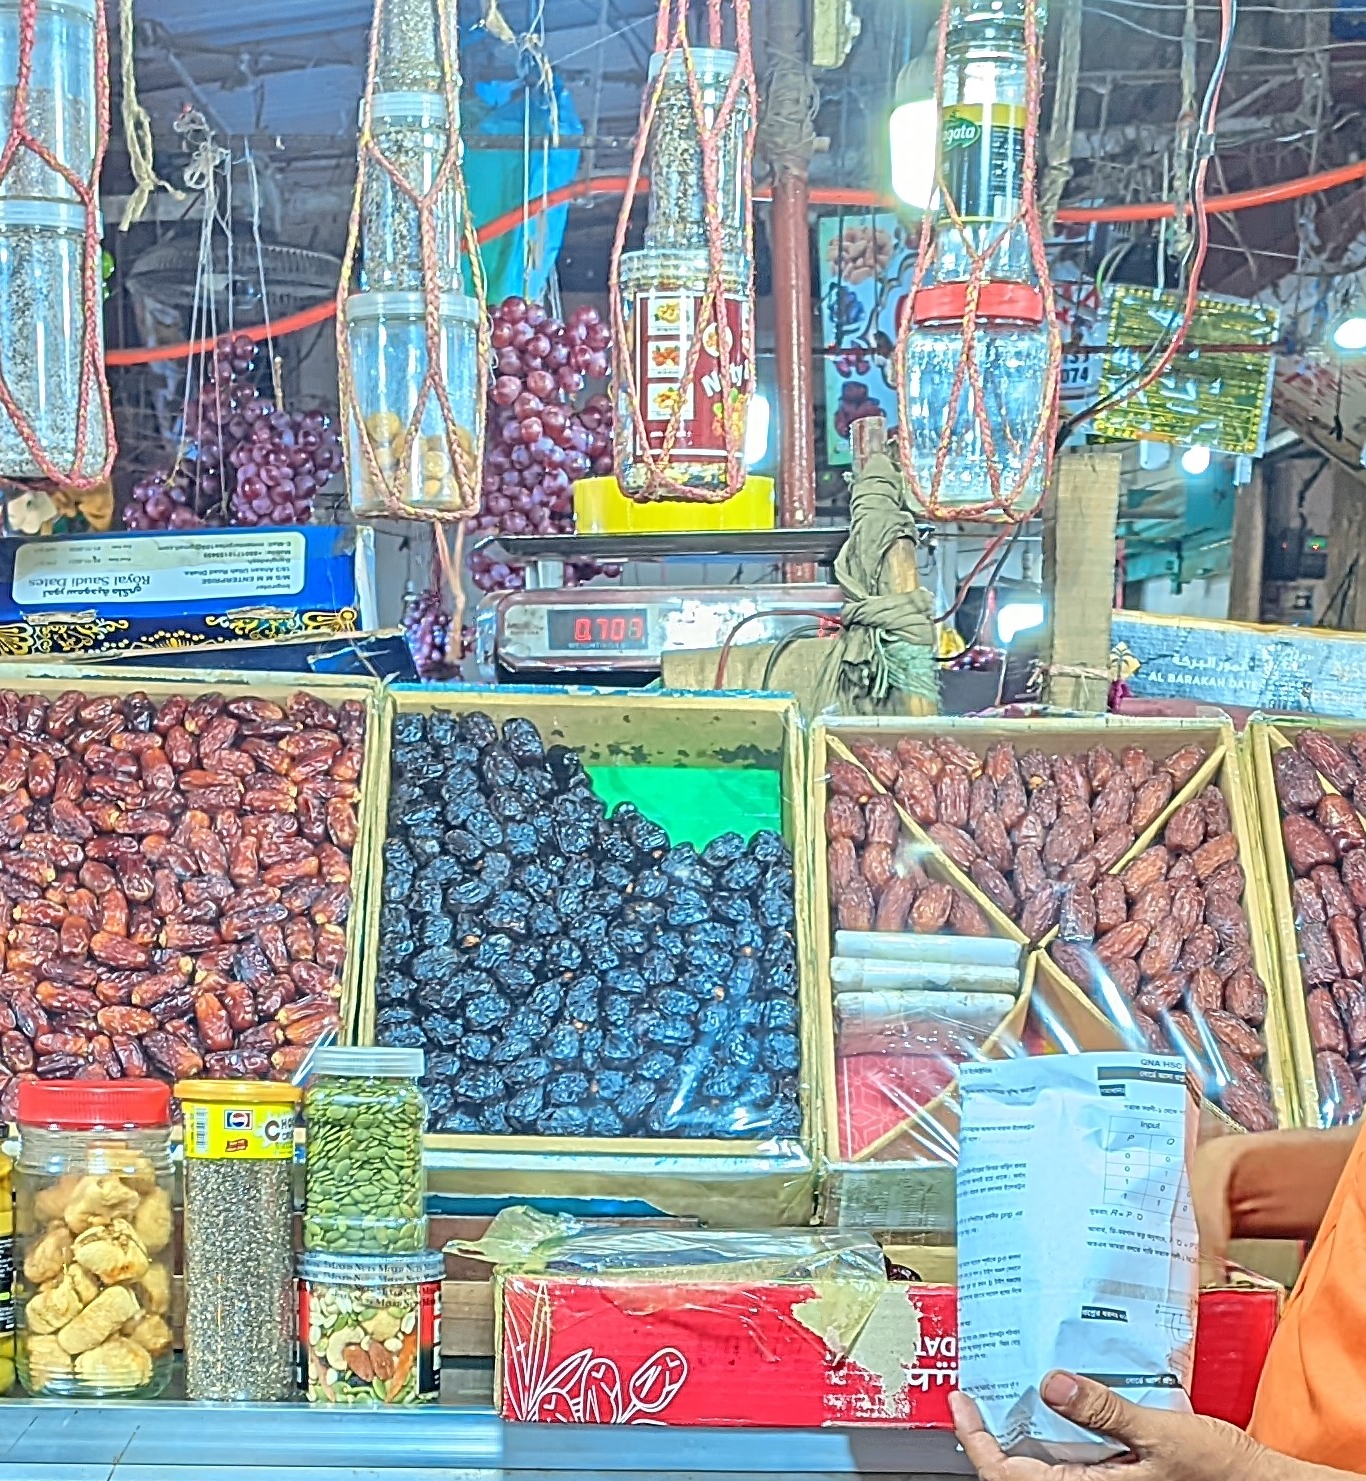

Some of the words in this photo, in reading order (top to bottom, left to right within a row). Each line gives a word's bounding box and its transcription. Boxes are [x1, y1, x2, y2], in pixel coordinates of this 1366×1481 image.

[28, 578, 67, 589] Dates
[71, 576, 110, 588] Saudi
[114, 574, 150, 588] Royal
[1147, 672, 1165, 683] AL
[1167, 673, 1226, 689] BARAKAH
[1163, 1060, 1183, 1069] HSC
[1140, 1121, 1161, 1129] Input
